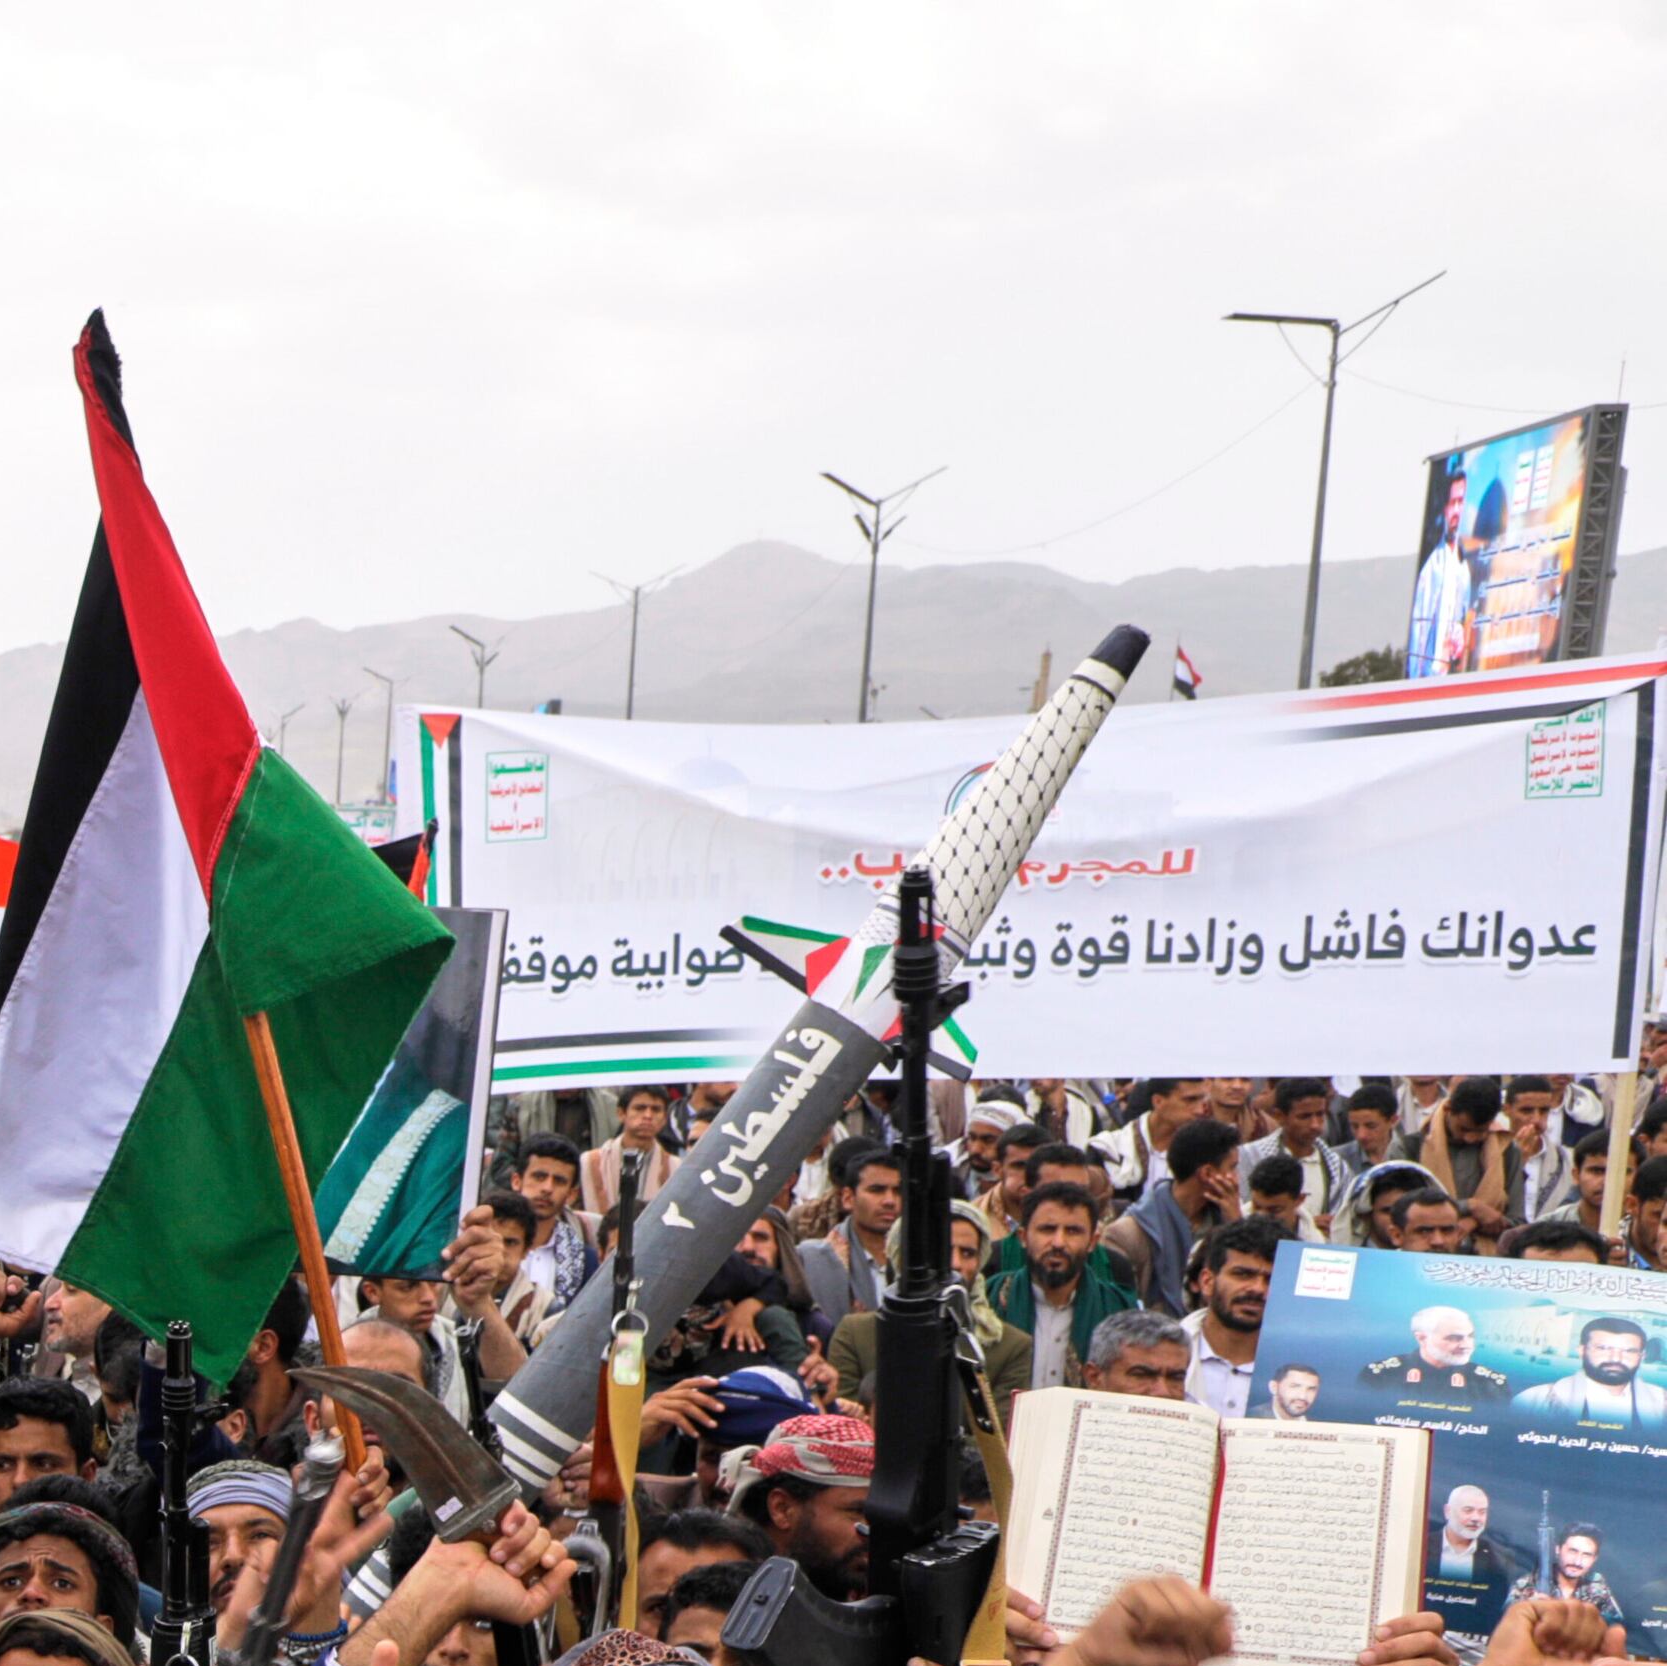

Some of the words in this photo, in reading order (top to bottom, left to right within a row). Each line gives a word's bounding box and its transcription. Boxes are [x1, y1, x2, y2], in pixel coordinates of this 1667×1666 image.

[1049, 914, 1131, 978] قوة
[1146, 916, 1266, 977] وزادنا
[1278, 907, 1407, 974] فاشل
[1422, 909, 1598, 973] عدوانك
[699, 1025, 844, 1208] فلسطين
[1421, 1420, 1453, 1431] قاسم
[1517, 1430, 1558, 1446] الحوثي
[1557, 1436, 1588, 1449] الدين
[1608, 1440, 1640, 1454] حسين
